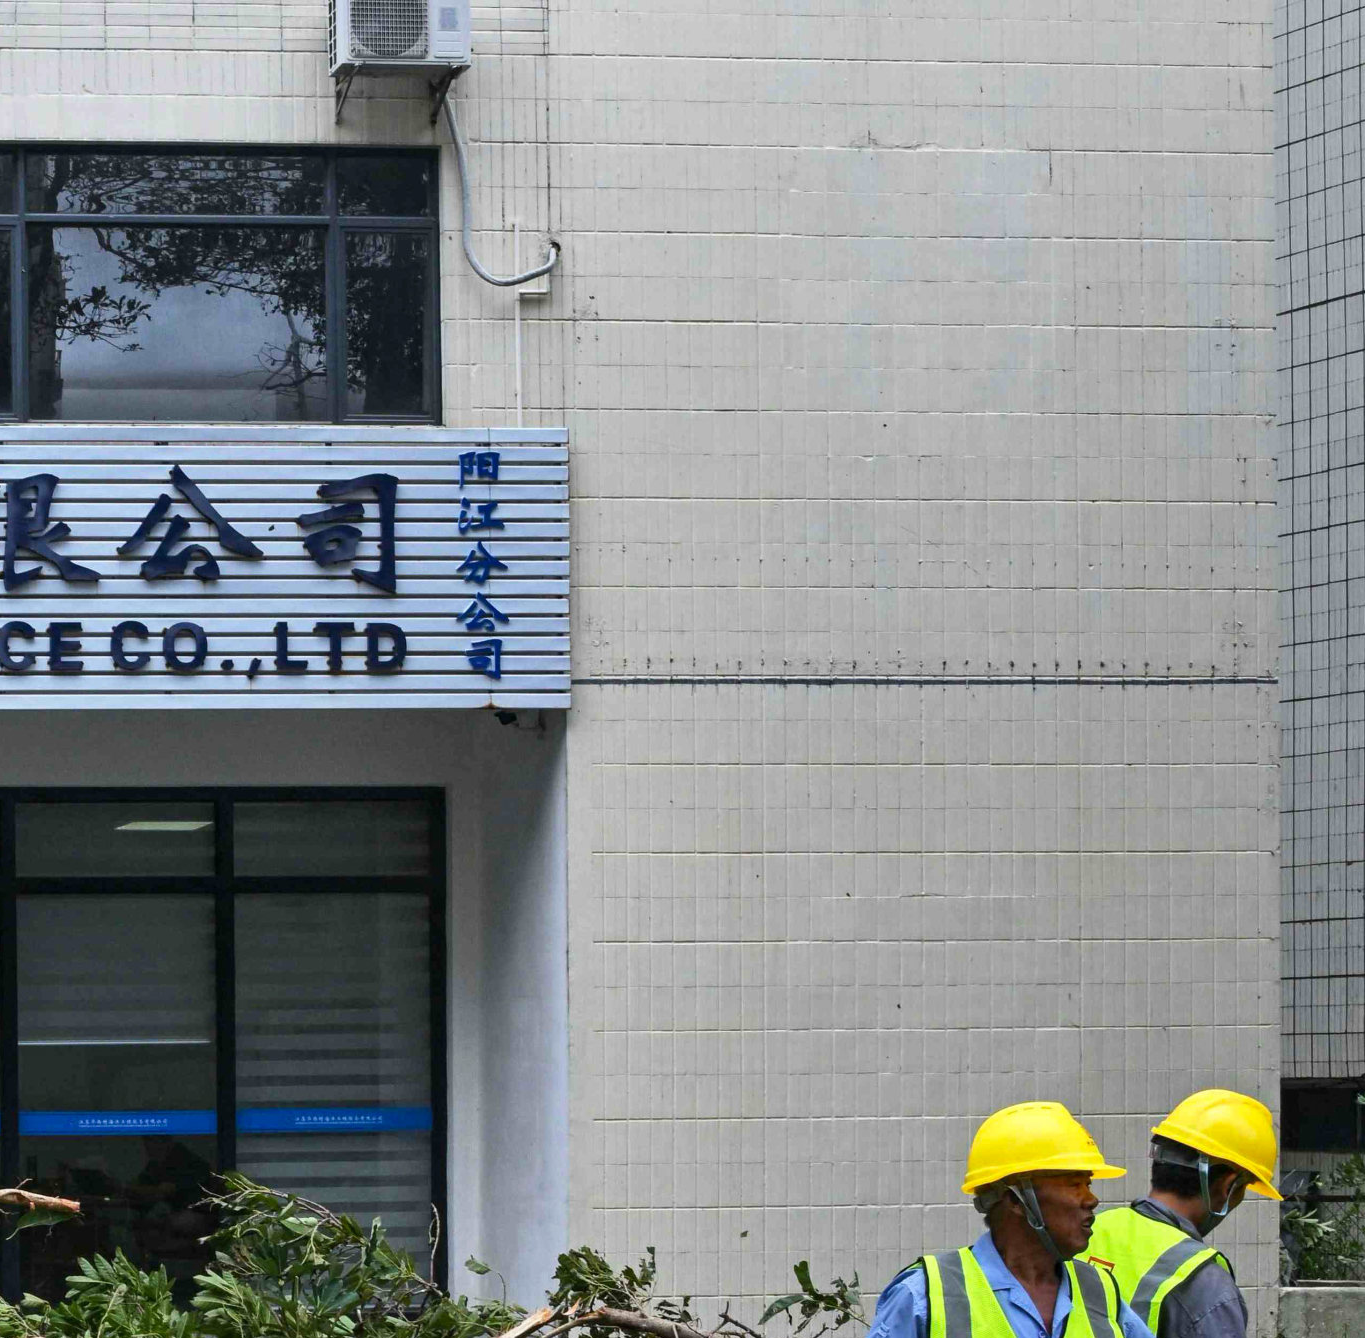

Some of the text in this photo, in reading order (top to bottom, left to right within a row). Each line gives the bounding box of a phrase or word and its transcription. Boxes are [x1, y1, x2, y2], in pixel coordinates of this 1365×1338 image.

[456, 451, 510, 680] 阳江分公司
